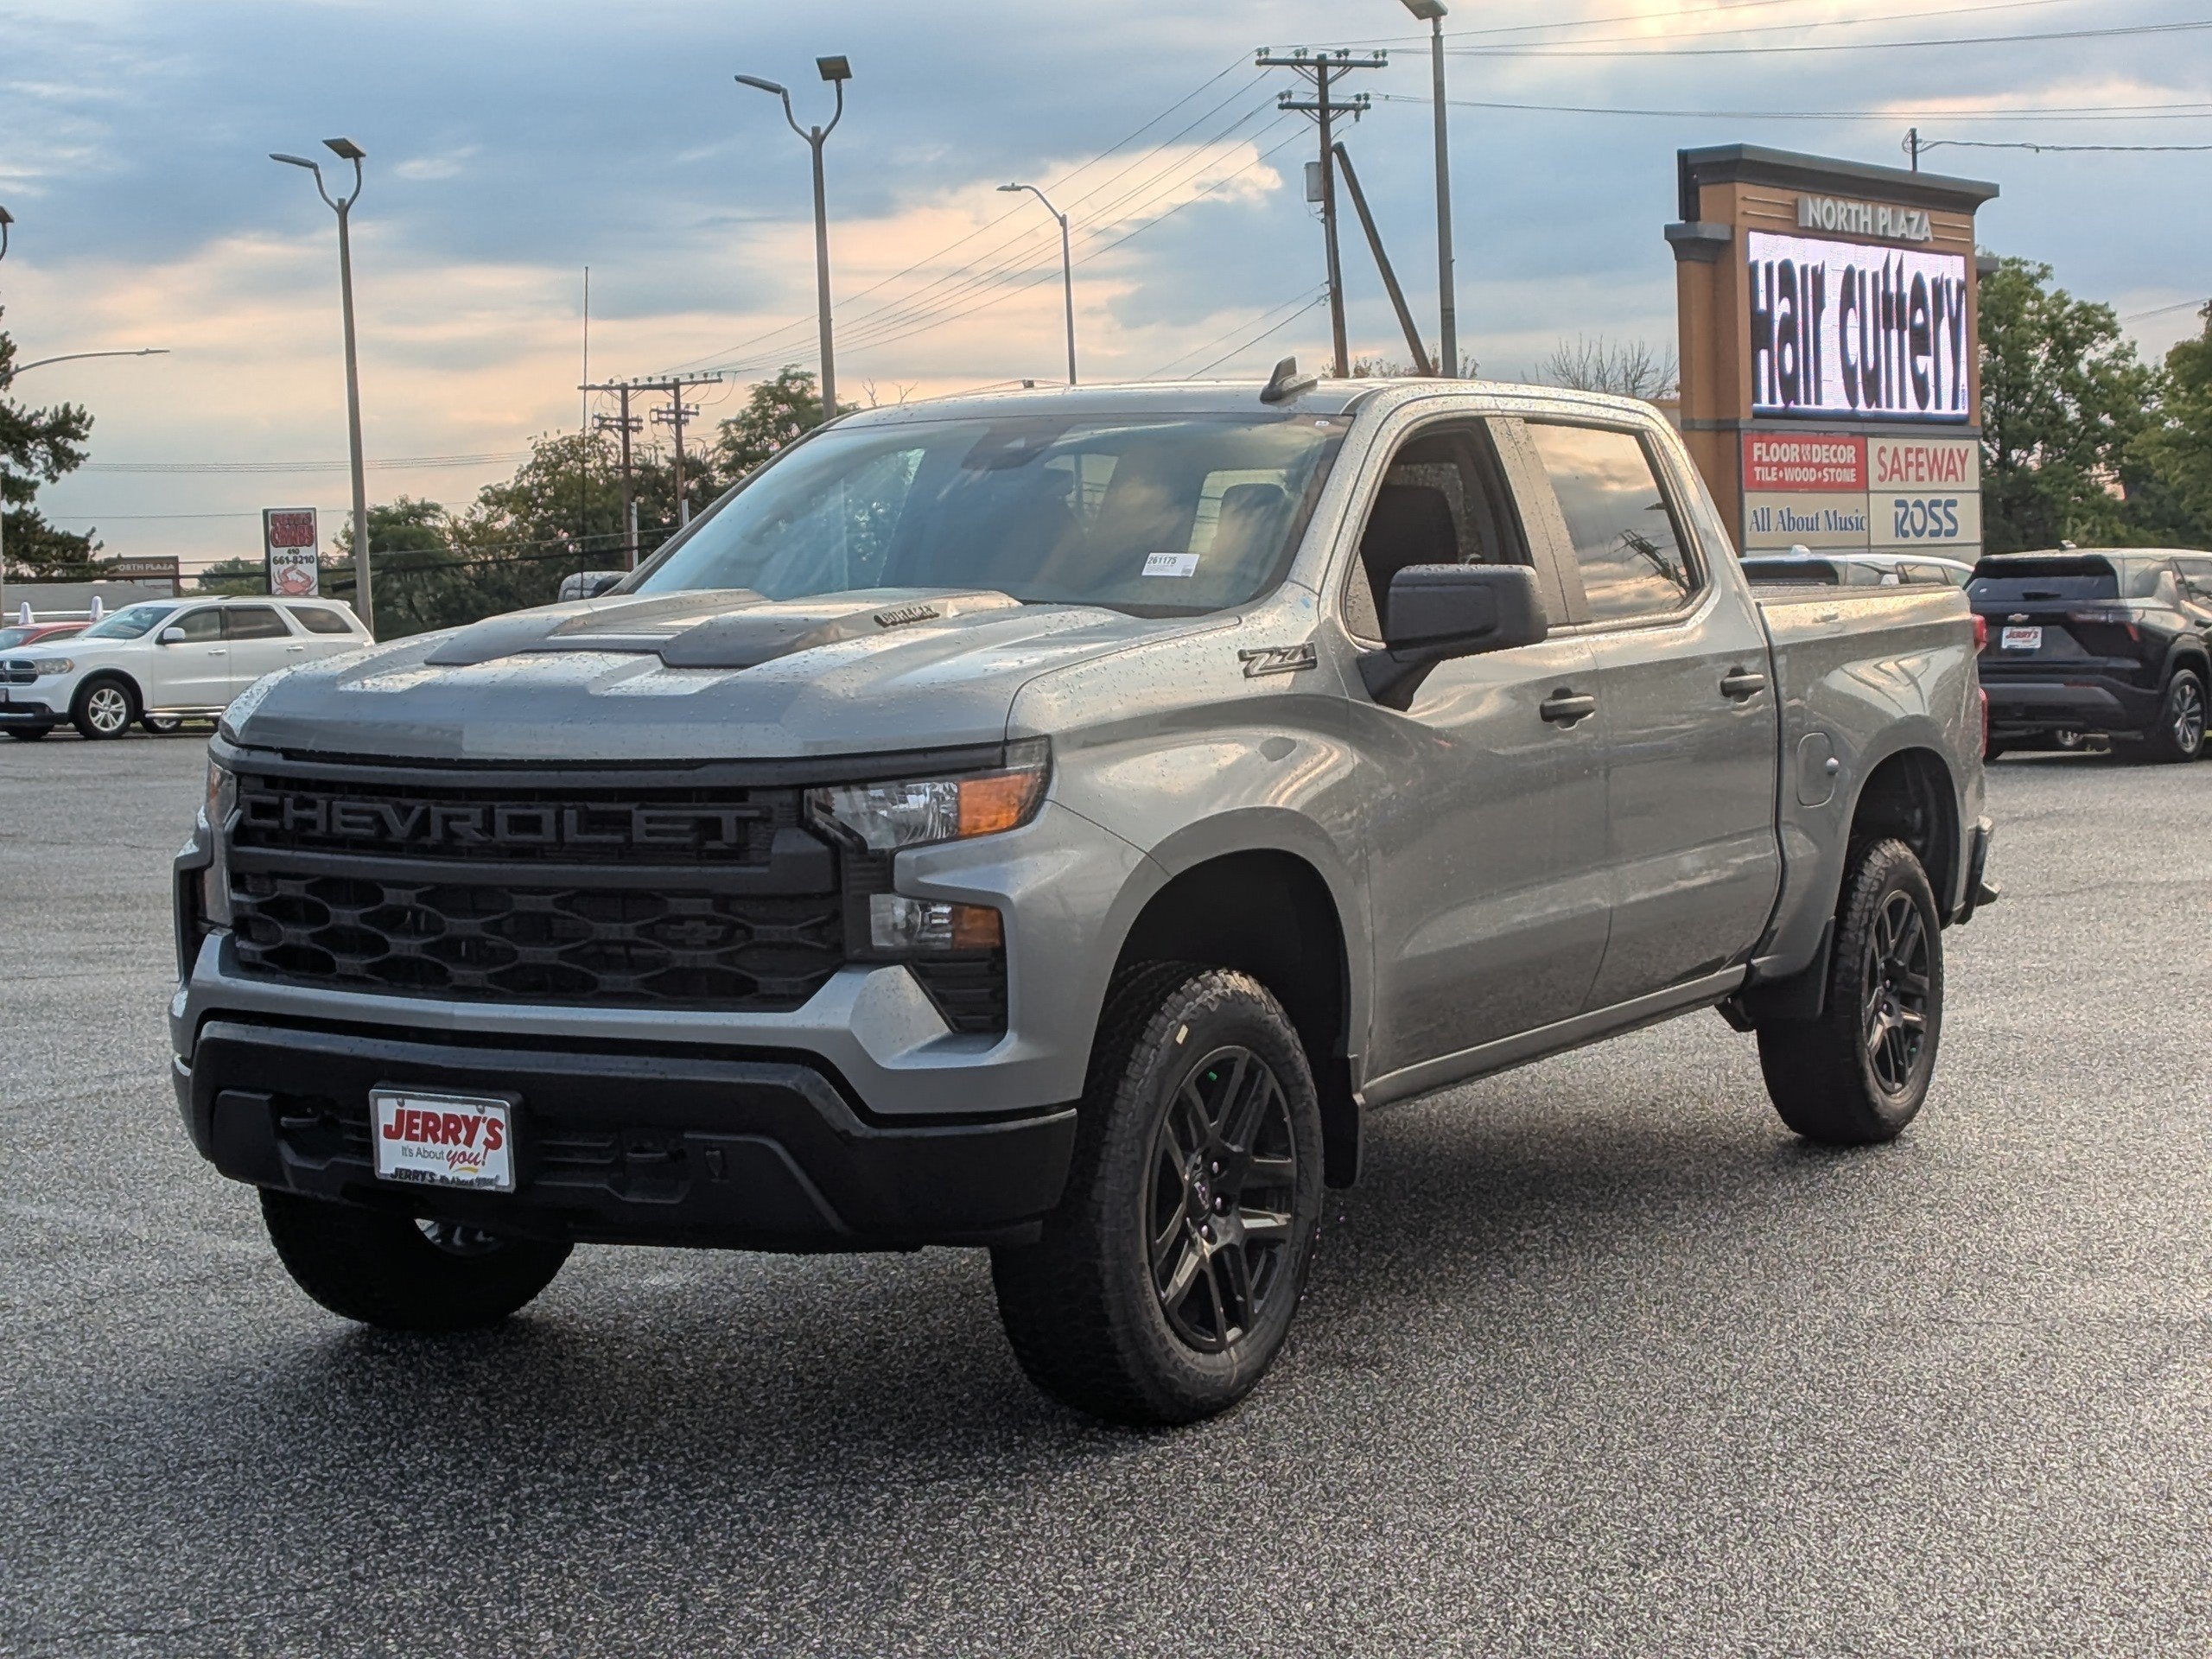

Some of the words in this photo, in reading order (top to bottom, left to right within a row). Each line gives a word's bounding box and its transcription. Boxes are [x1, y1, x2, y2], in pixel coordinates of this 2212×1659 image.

[1799, 195, 1872, 235] NORTH
[1872, 206, 1934, 242] PLAZA
[1749, 258, 1827, 409] Hair
[1752, 442, 1800, 462] FLOOR
[1811, 443, 1856, 464] DECOR
[1877, 445, 1970, 483] SAFEWAY
[1753, 466, 1778, 481] TILE
[1783, 467, 1816, 482] WOOD
[1822, 467, 1857, 483] STONE
[1749, 506, 1771, 532] All
[1775, 506, 1821, 532] About
[1823, 508, 1866, 532] Music
[1893, 499, 1959, 538] ROSS
[243, 793, 762, 847] CHEVROLET
[383, 1109, 505, 1151] JERRY'S
[402, 1146, 414, 1157] It's
[416, 1147, 444, 1160] About
[390, 1166, 436, 1183] JERRY'S
